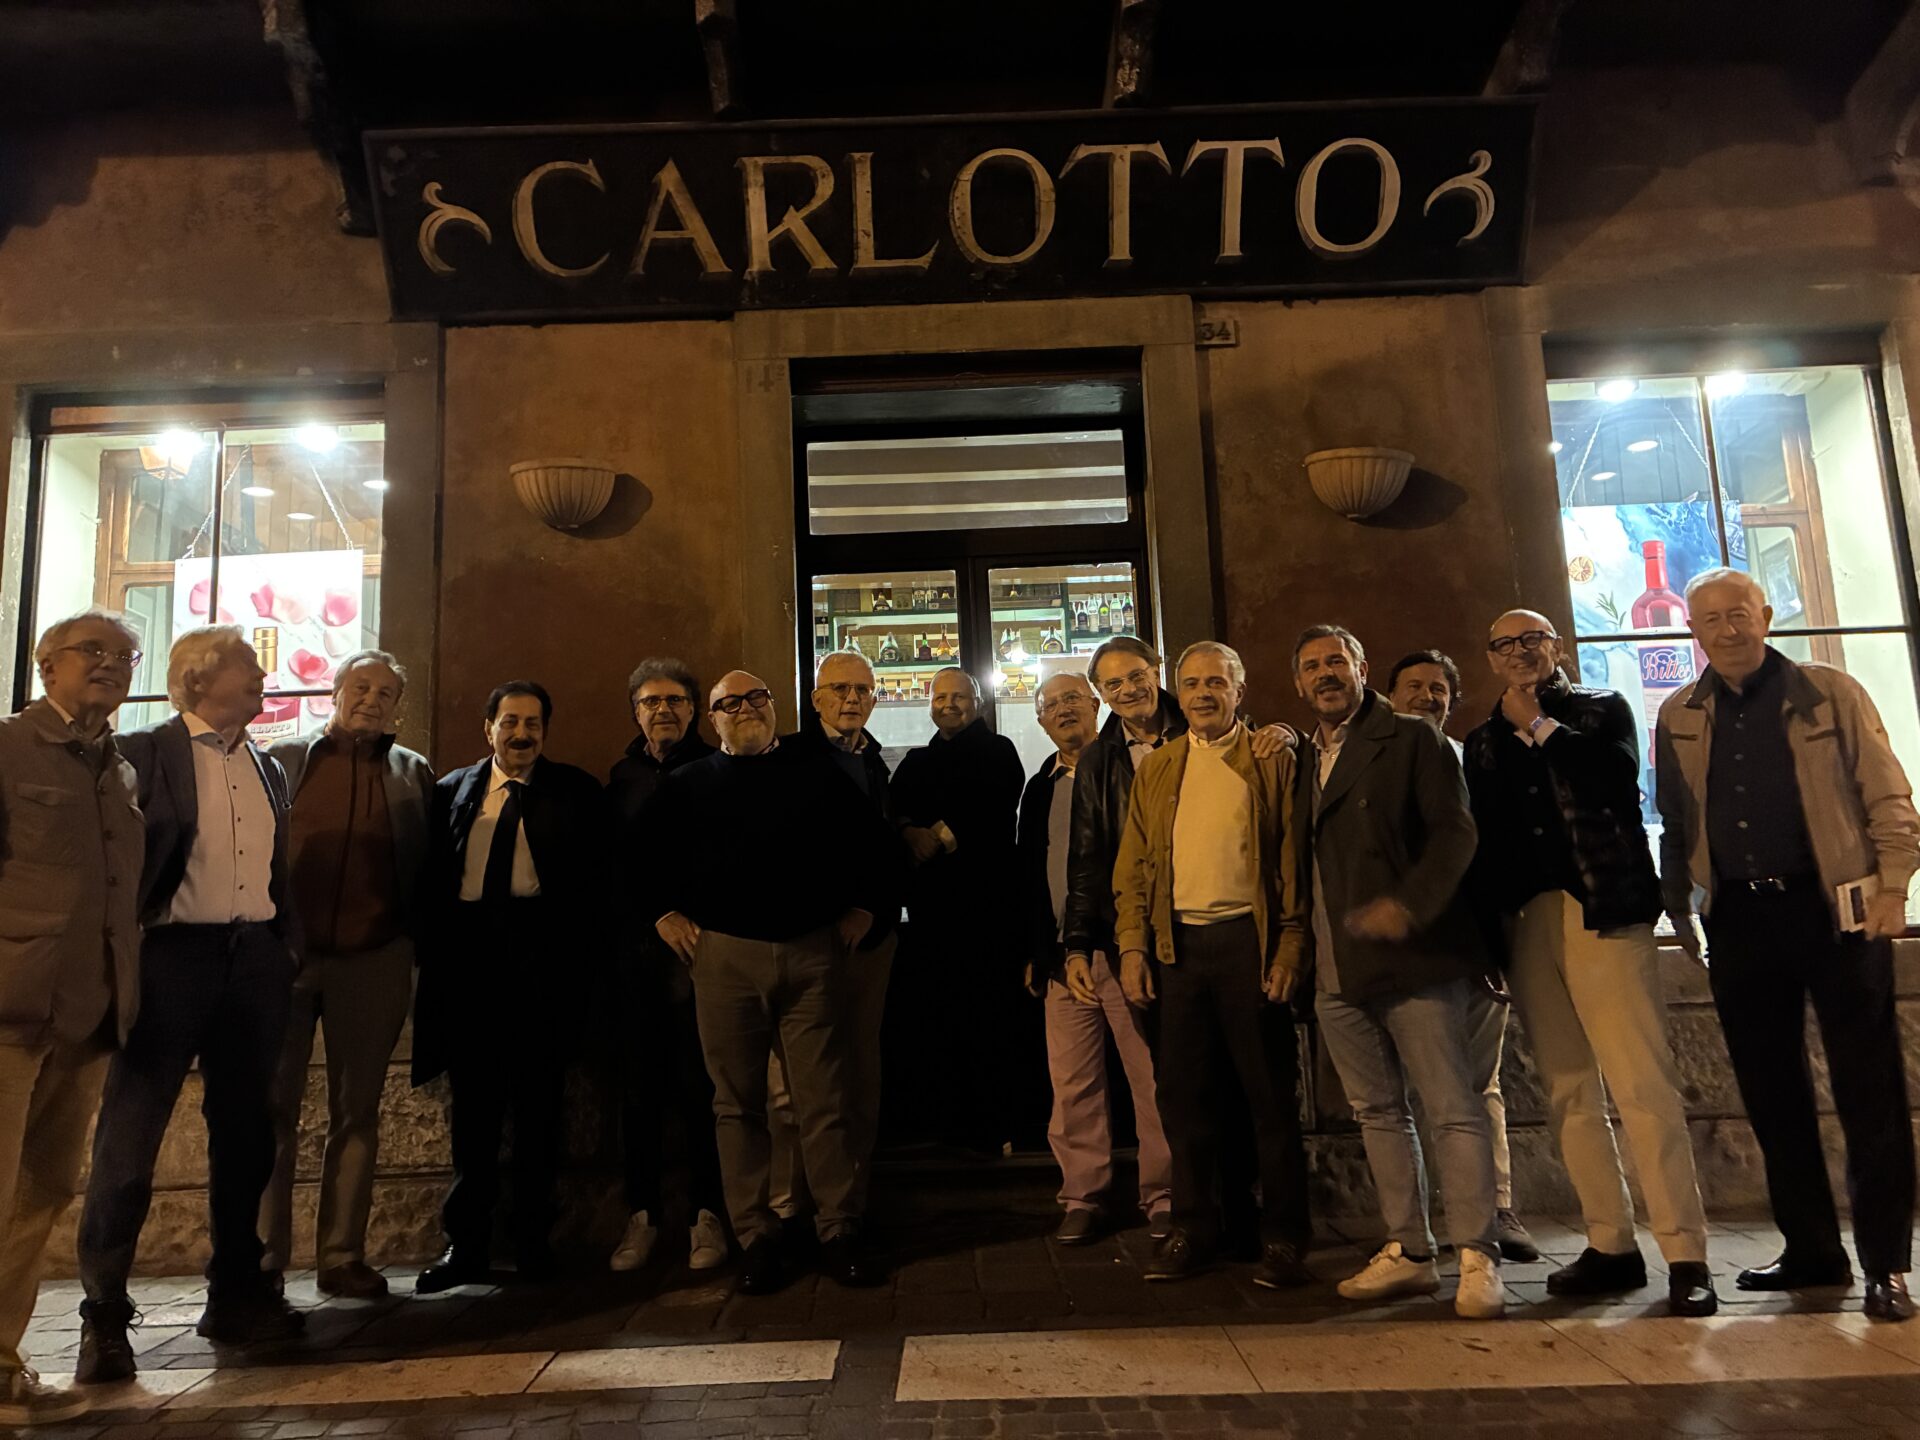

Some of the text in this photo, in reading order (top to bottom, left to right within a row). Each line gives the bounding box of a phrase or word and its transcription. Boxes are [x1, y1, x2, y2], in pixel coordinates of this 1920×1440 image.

[512, 137, 1401, 279] CARLOTTO
[1200, 321, 1231, 341] 34
[1642, 648, 1692, 682] Bitter
